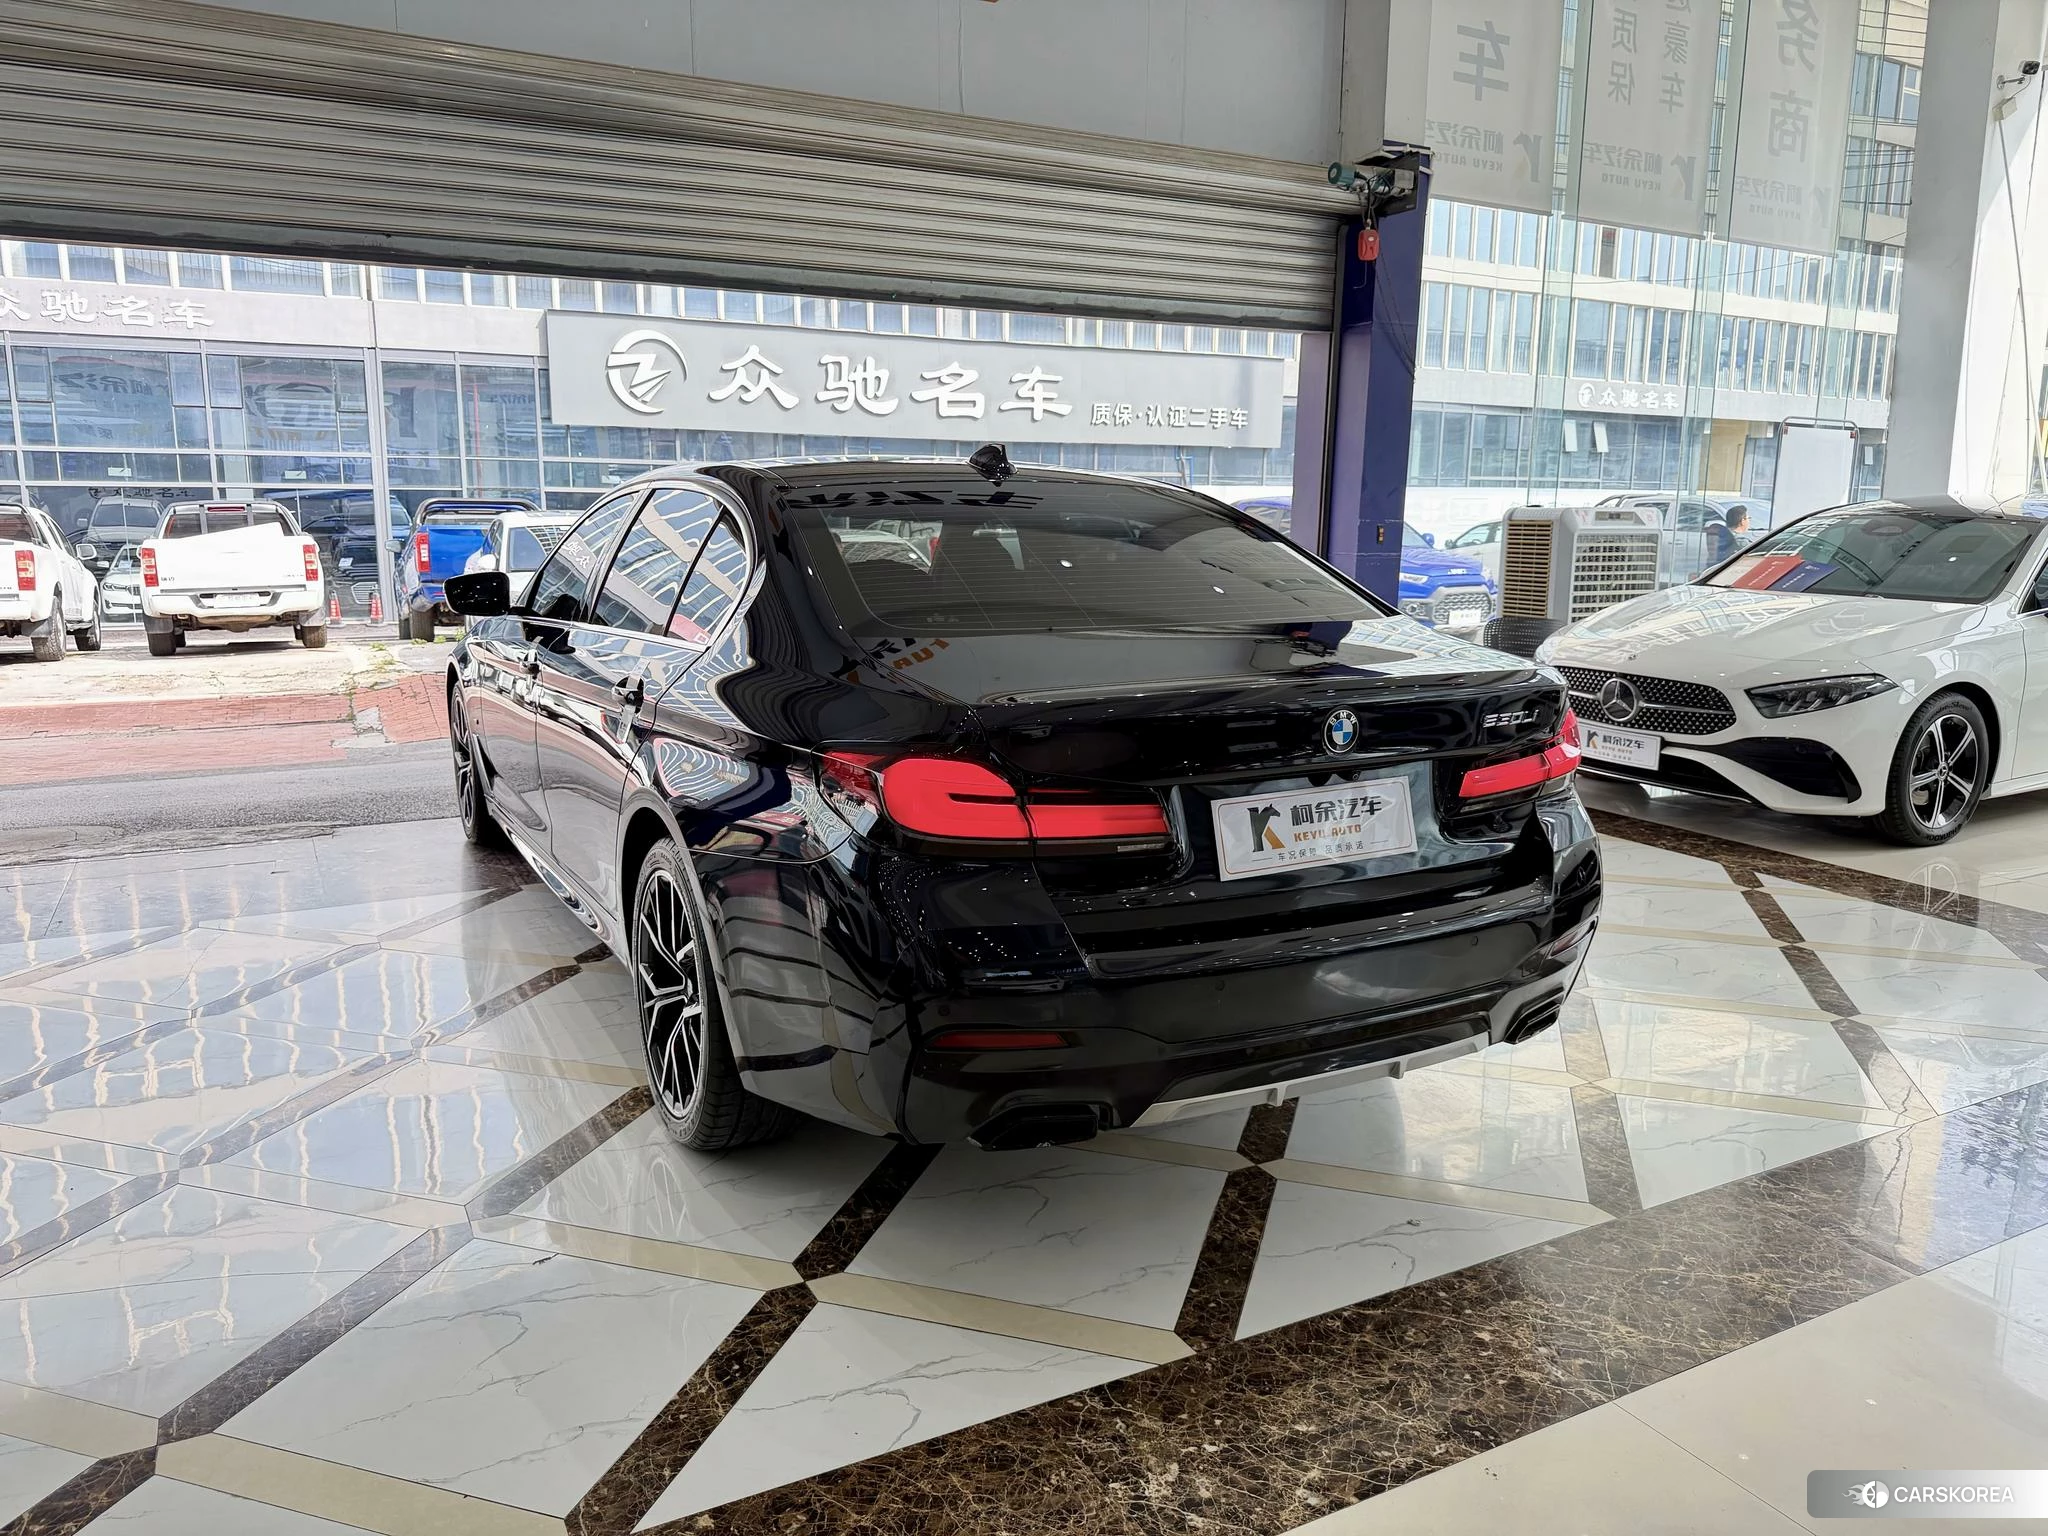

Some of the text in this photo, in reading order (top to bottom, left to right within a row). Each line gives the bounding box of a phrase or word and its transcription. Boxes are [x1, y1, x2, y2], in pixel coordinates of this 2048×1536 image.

[709, 345, 1073, 421] 众驰名车
[1597, 387, 1680, 410] 众驰名车
[1092, 403, 1249, 429] 质保·认证二手车
[1602, 734, 1645, 750] 柯余汽车
[1290, 795, 1383, 827] 柯余汽车
[1331, 824, 1362, 837] AUTO
